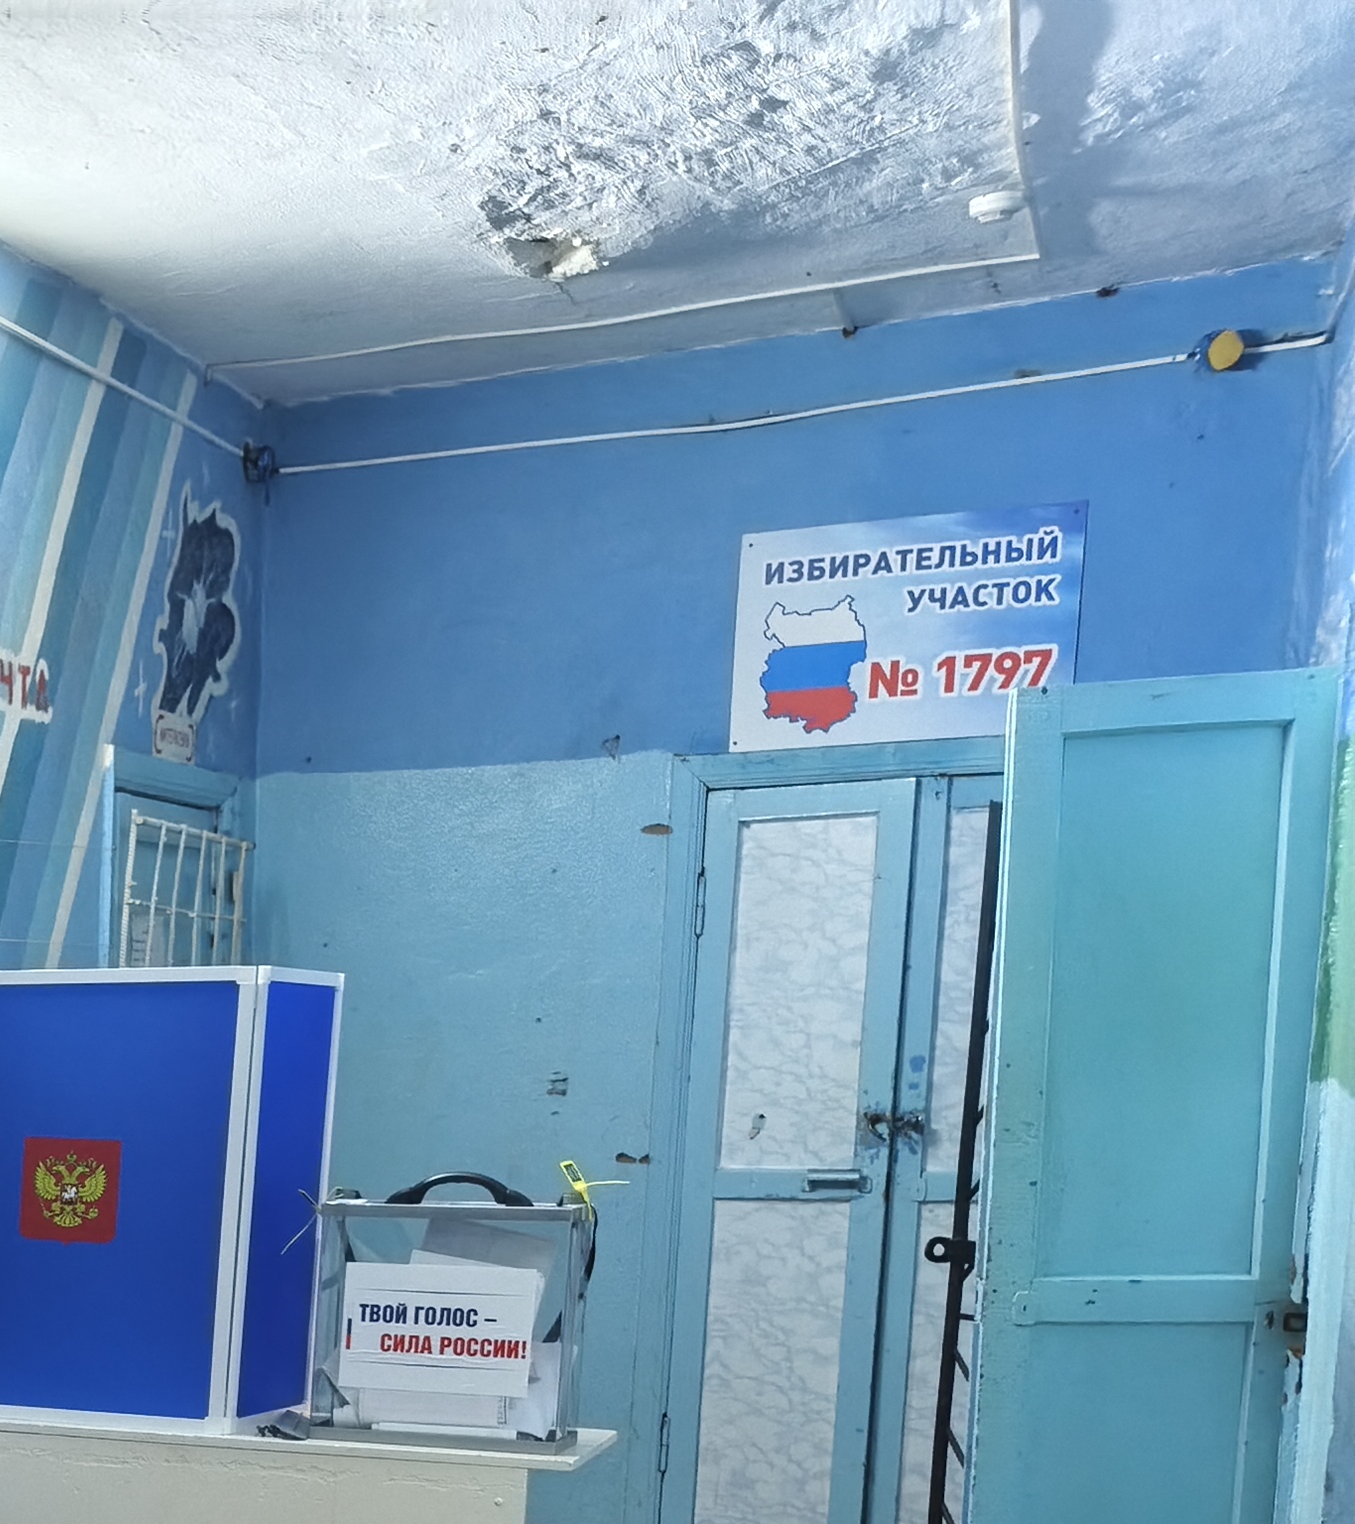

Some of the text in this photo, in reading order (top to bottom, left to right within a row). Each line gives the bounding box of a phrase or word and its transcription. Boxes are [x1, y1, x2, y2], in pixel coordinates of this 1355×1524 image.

[765, 529, 1060, 586] ИЗБИРАТЕЛЬНЫЙ
[906, 577, 1057, 613] УЧАСТОК
[868, 649, 1054, 700] № 1797
[359, 1303, 408, 1325] ТВОЙ
[413, 1306, 479, 1328] ГОЛОС
[380, 1333, 527, 1359] СИЛА РОССИИ!
